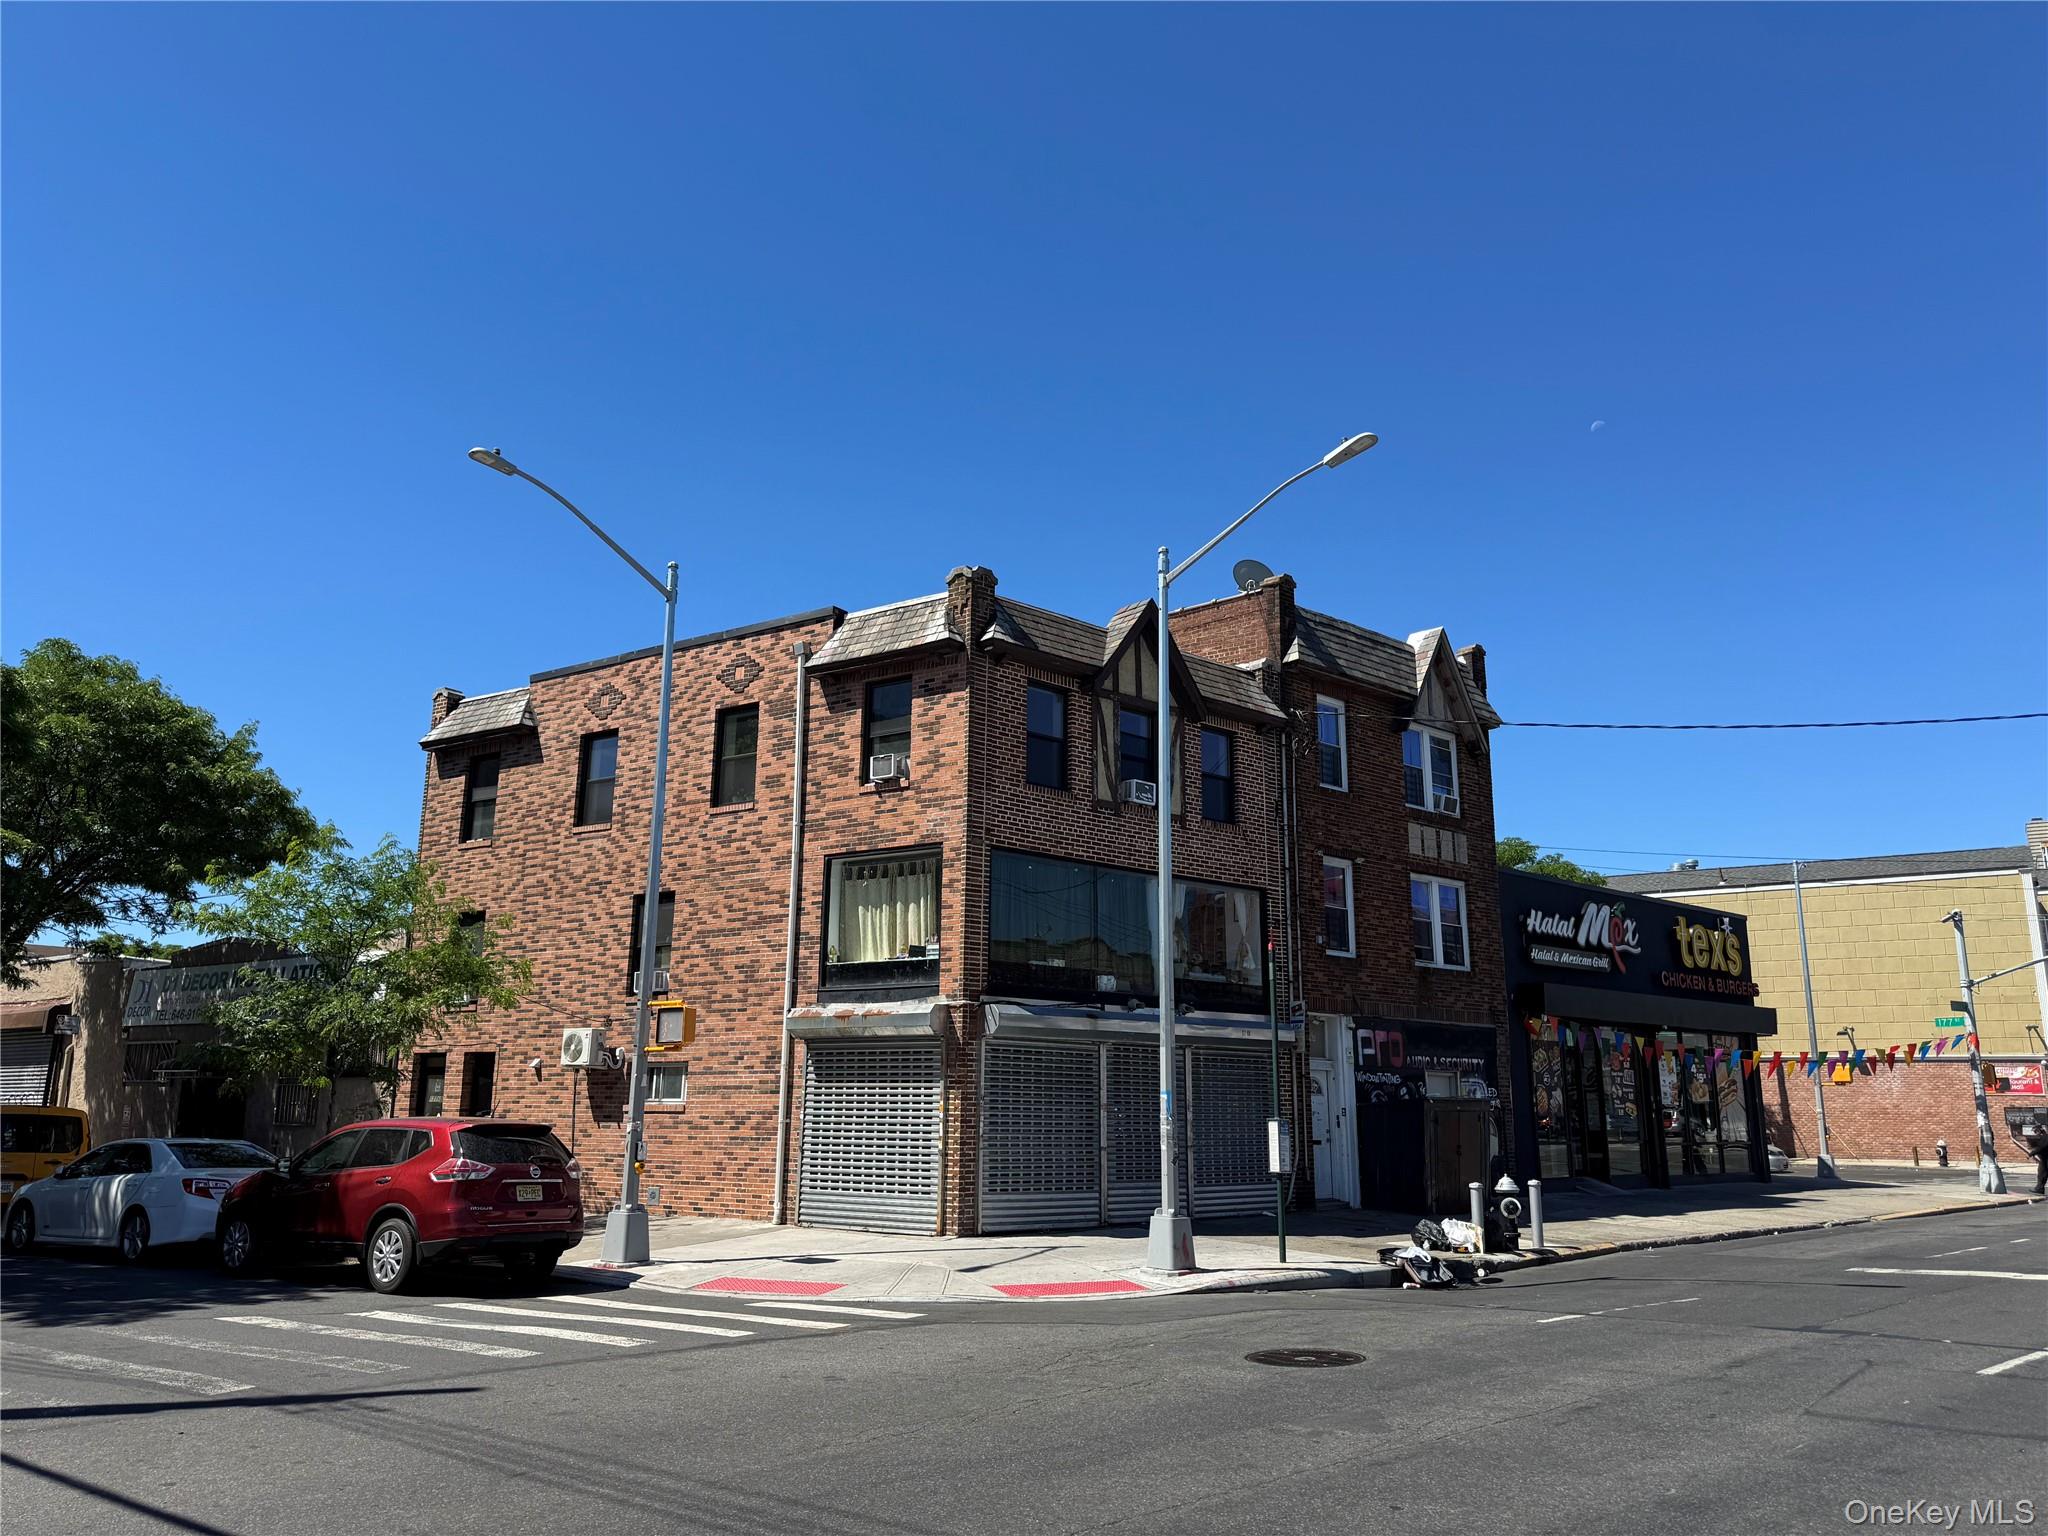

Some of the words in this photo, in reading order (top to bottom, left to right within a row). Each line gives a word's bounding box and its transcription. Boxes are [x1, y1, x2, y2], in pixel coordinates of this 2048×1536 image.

[1526, 908, 1576, 939] Halal
[1530, 948, 1553, 961] Halal
[1553, 953, 1559, 962] &
[1560, 952, 1592, 966] Mexican
[1592, 957, 1609, 968] Grill
[181, 970, 229, 992] DECOR
[1661, 970, 1706, 991] CHICKEN
[1707, 978, 1715, 992] &
[1716, 978, 1760, 997] BURGERS
[127, 1006, 151, 1018] DECOR
[1440, 1057, 1485, 1072] SECURITY
